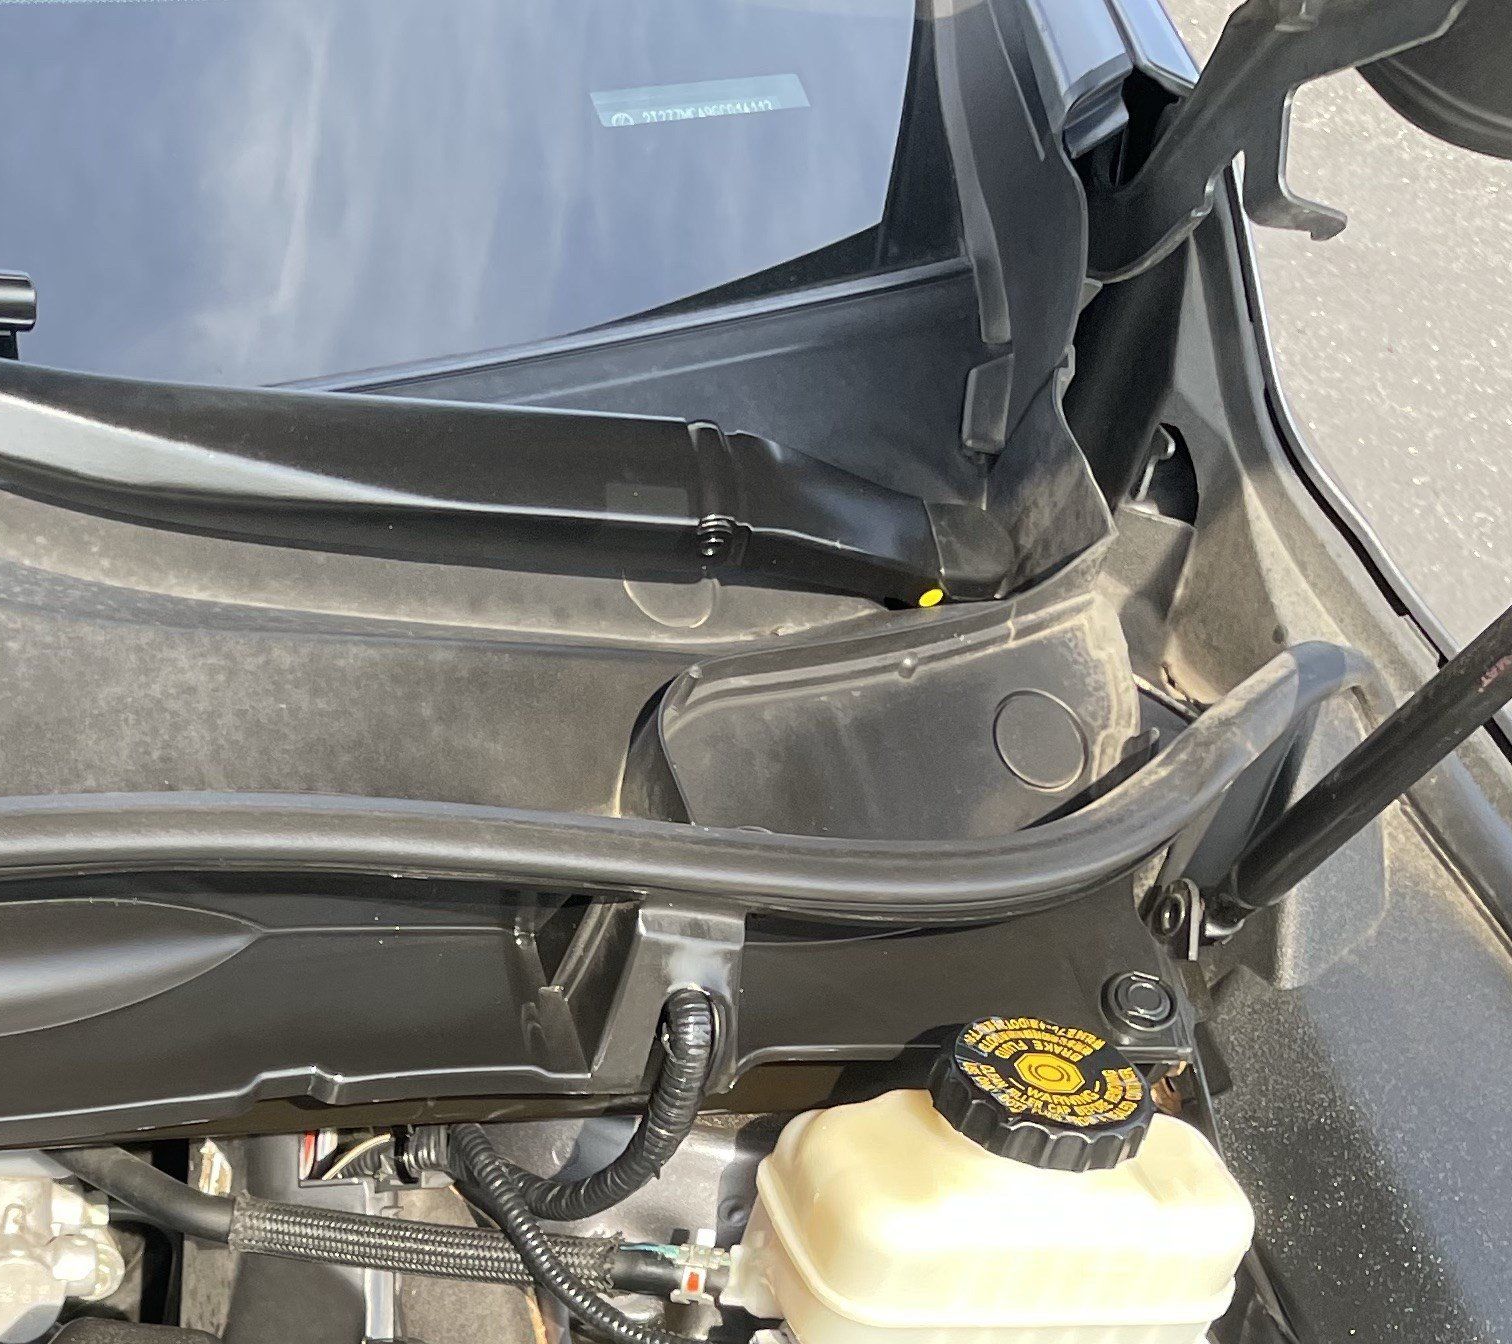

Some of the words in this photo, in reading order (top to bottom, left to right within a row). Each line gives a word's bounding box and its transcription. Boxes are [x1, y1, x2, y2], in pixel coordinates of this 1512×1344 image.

[994, 1039, 1029, 1059] FLUID
[1033, 1038, 1085, 1062] BRAKE
[1027, 1085, 1099, 1106] WARNING
